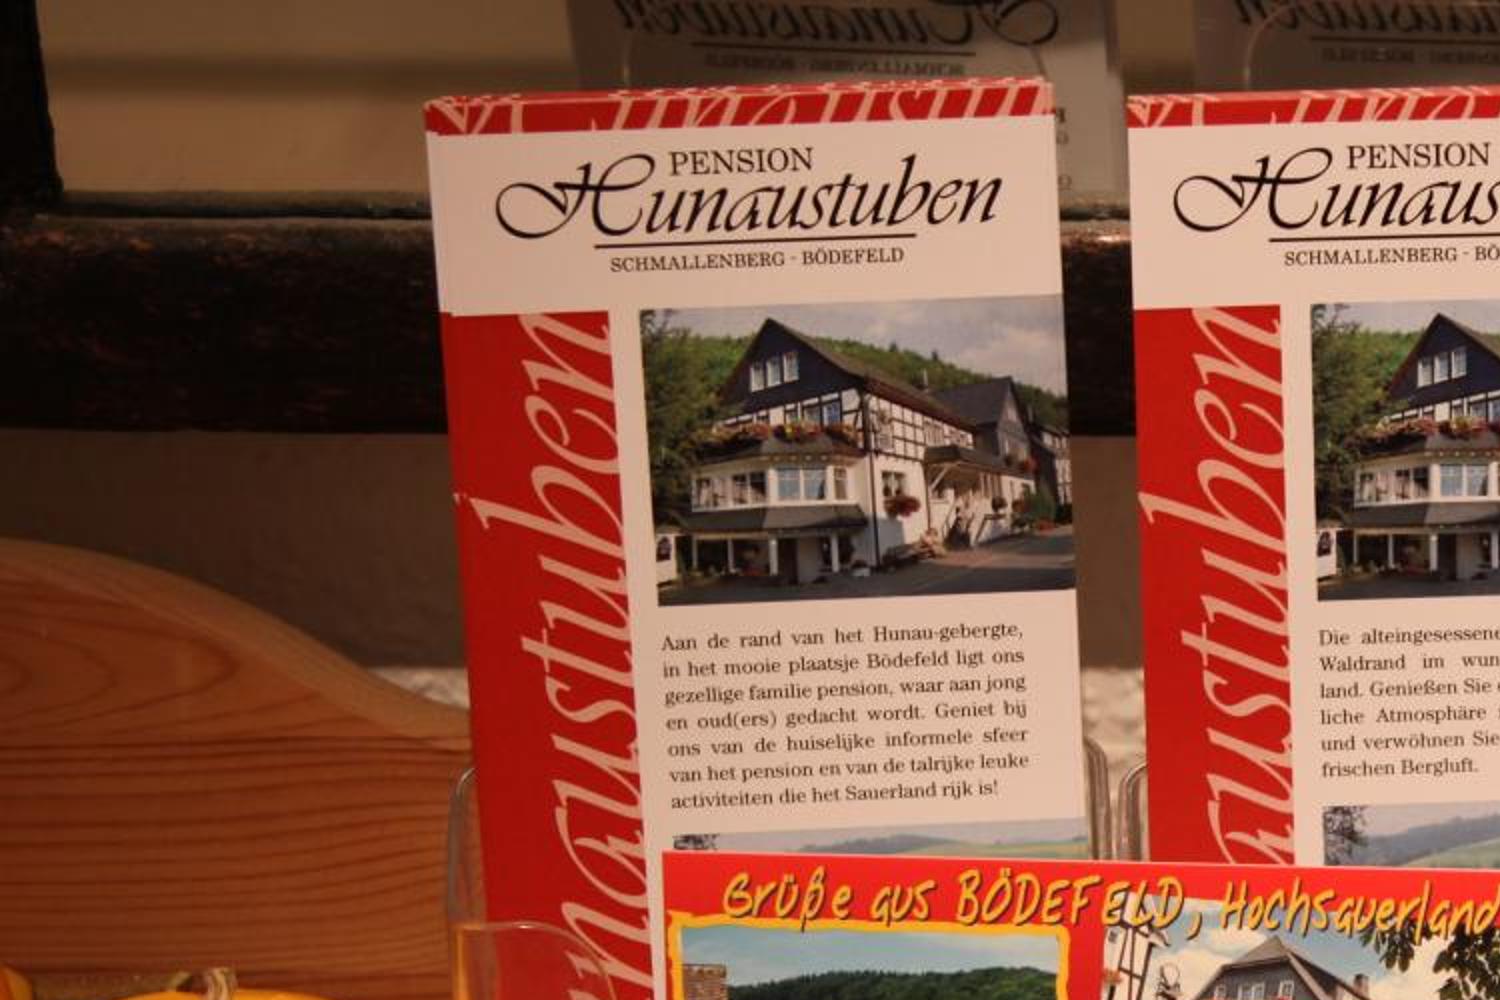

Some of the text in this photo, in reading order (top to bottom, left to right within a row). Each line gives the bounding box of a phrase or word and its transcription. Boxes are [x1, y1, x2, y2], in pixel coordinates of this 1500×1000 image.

[669, 147, 814, 176] PENSION
[1346, 142, 1491, 170] PENSION
[495, 153, 1003, 238] Hunaustuben
[610, 251, 786, 273] SCHMALLENBERG
[802, 247, 904, 266] BÖDEFELD
[1284, 247, 1457, 267] SCHMALLENBERG
[661, 624, 1024, 651] Aan de rand van het Hunau-gebergte,
[1319, 629, 1350, 646] Die
[664, 650, 1025, 678] in het mooie plaatsje Bödefeld ligt ons
[1319, 655, 1406, 672] Waldrand
[1423, 653, 1444, 669] im
[665, 675, 1026, 707] gezellige familie pension, waar aan jong
[1320, 682, 1363, 698] land.
[1370, 680, 1458, 698] Genießen
[1463, 678, 1492, 694] Sie
[666, 700, 1028, 730] en oud(ers) gedacht wordt. Geniet bij
[1320, 709, 1365, 725] liche
[1376, 705, 1487, 725] Atmosphäre
[668, 728, 1029, 757] ons van de huiselijke informele sfeer
[1321, 735, 1355, 752] und
[1363, 731, 1465, 750] verwöhnen
[1473, 730, 1500, 747] Sie
[670, 753, 1029, 783] van het pension en van de talrijke leuke
[1322, 756, 1478, 778] frischen Bergluft.
[671, 779, 998, 809] activiteiten die het Sauerland rijk is!
[722, 864, 853, 934] Grüße
[871, 878, 938, 928] aus
